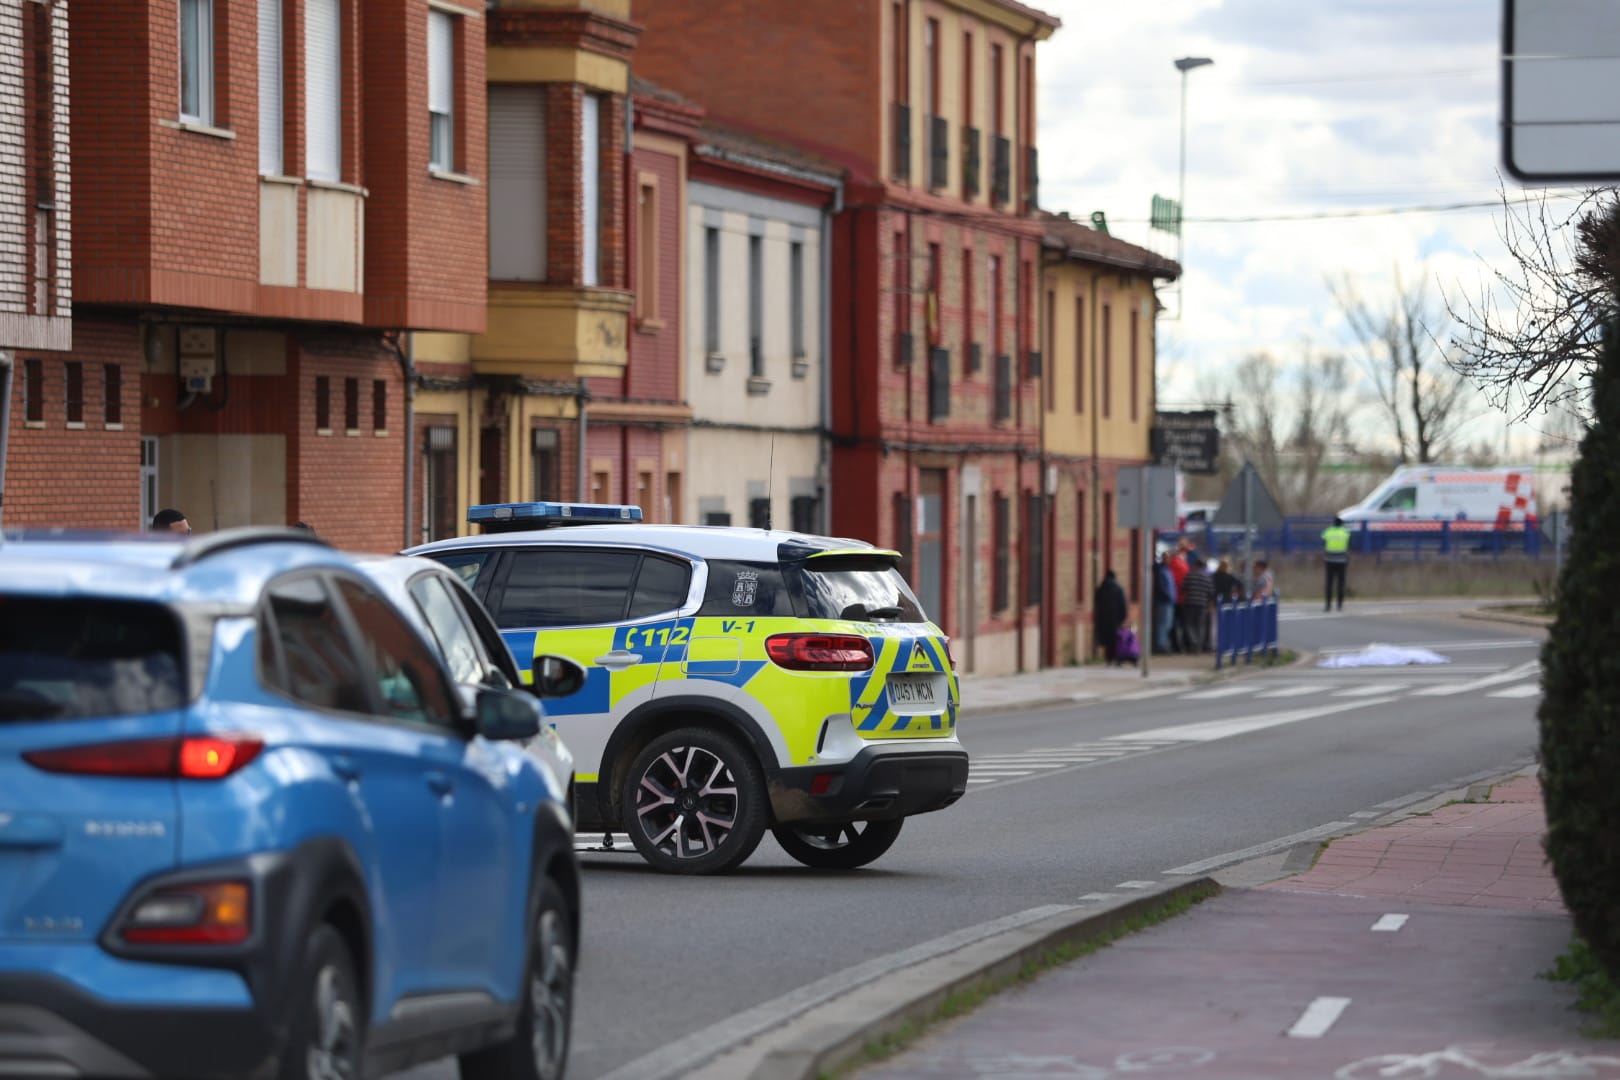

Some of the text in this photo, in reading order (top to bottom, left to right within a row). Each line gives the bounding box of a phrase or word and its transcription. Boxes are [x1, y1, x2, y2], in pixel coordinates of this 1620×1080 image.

[722, 620, 755, 633] V-1
[641, 627, 690, 647] 112
[894, 682, 915, 701] 0451
